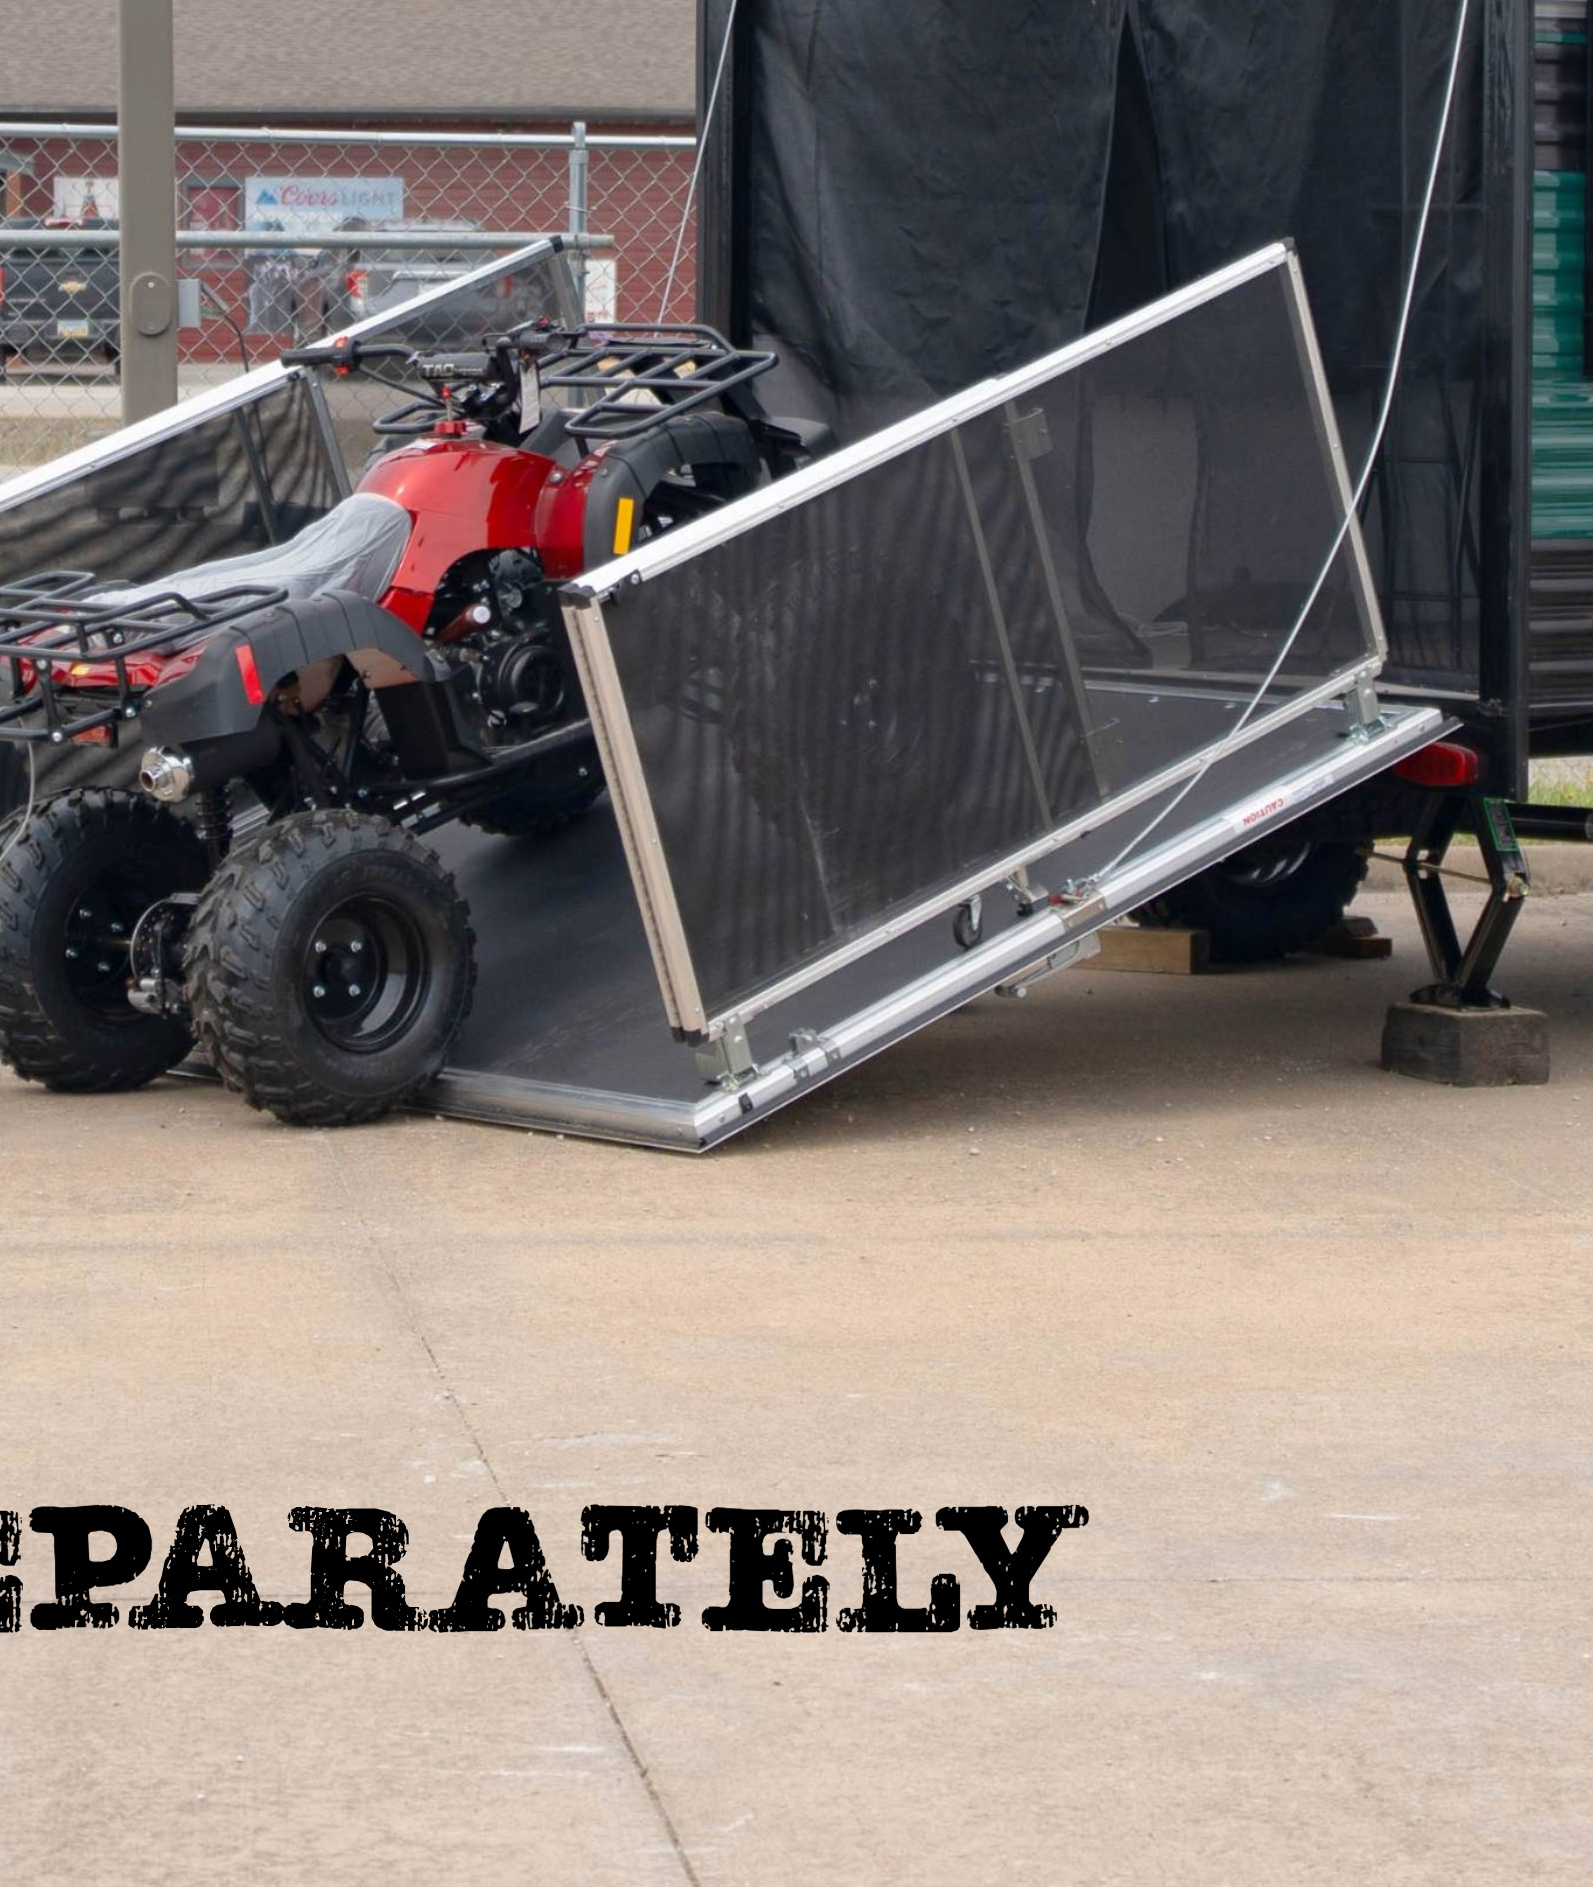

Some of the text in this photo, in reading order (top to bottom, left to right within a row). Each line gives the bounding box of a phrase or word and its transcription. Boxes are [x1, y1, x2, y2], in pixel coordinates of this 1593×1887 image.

[280, 185, 397, 207] Coors LIGHT
[1242, 797, 1285, 826] CAUTION
